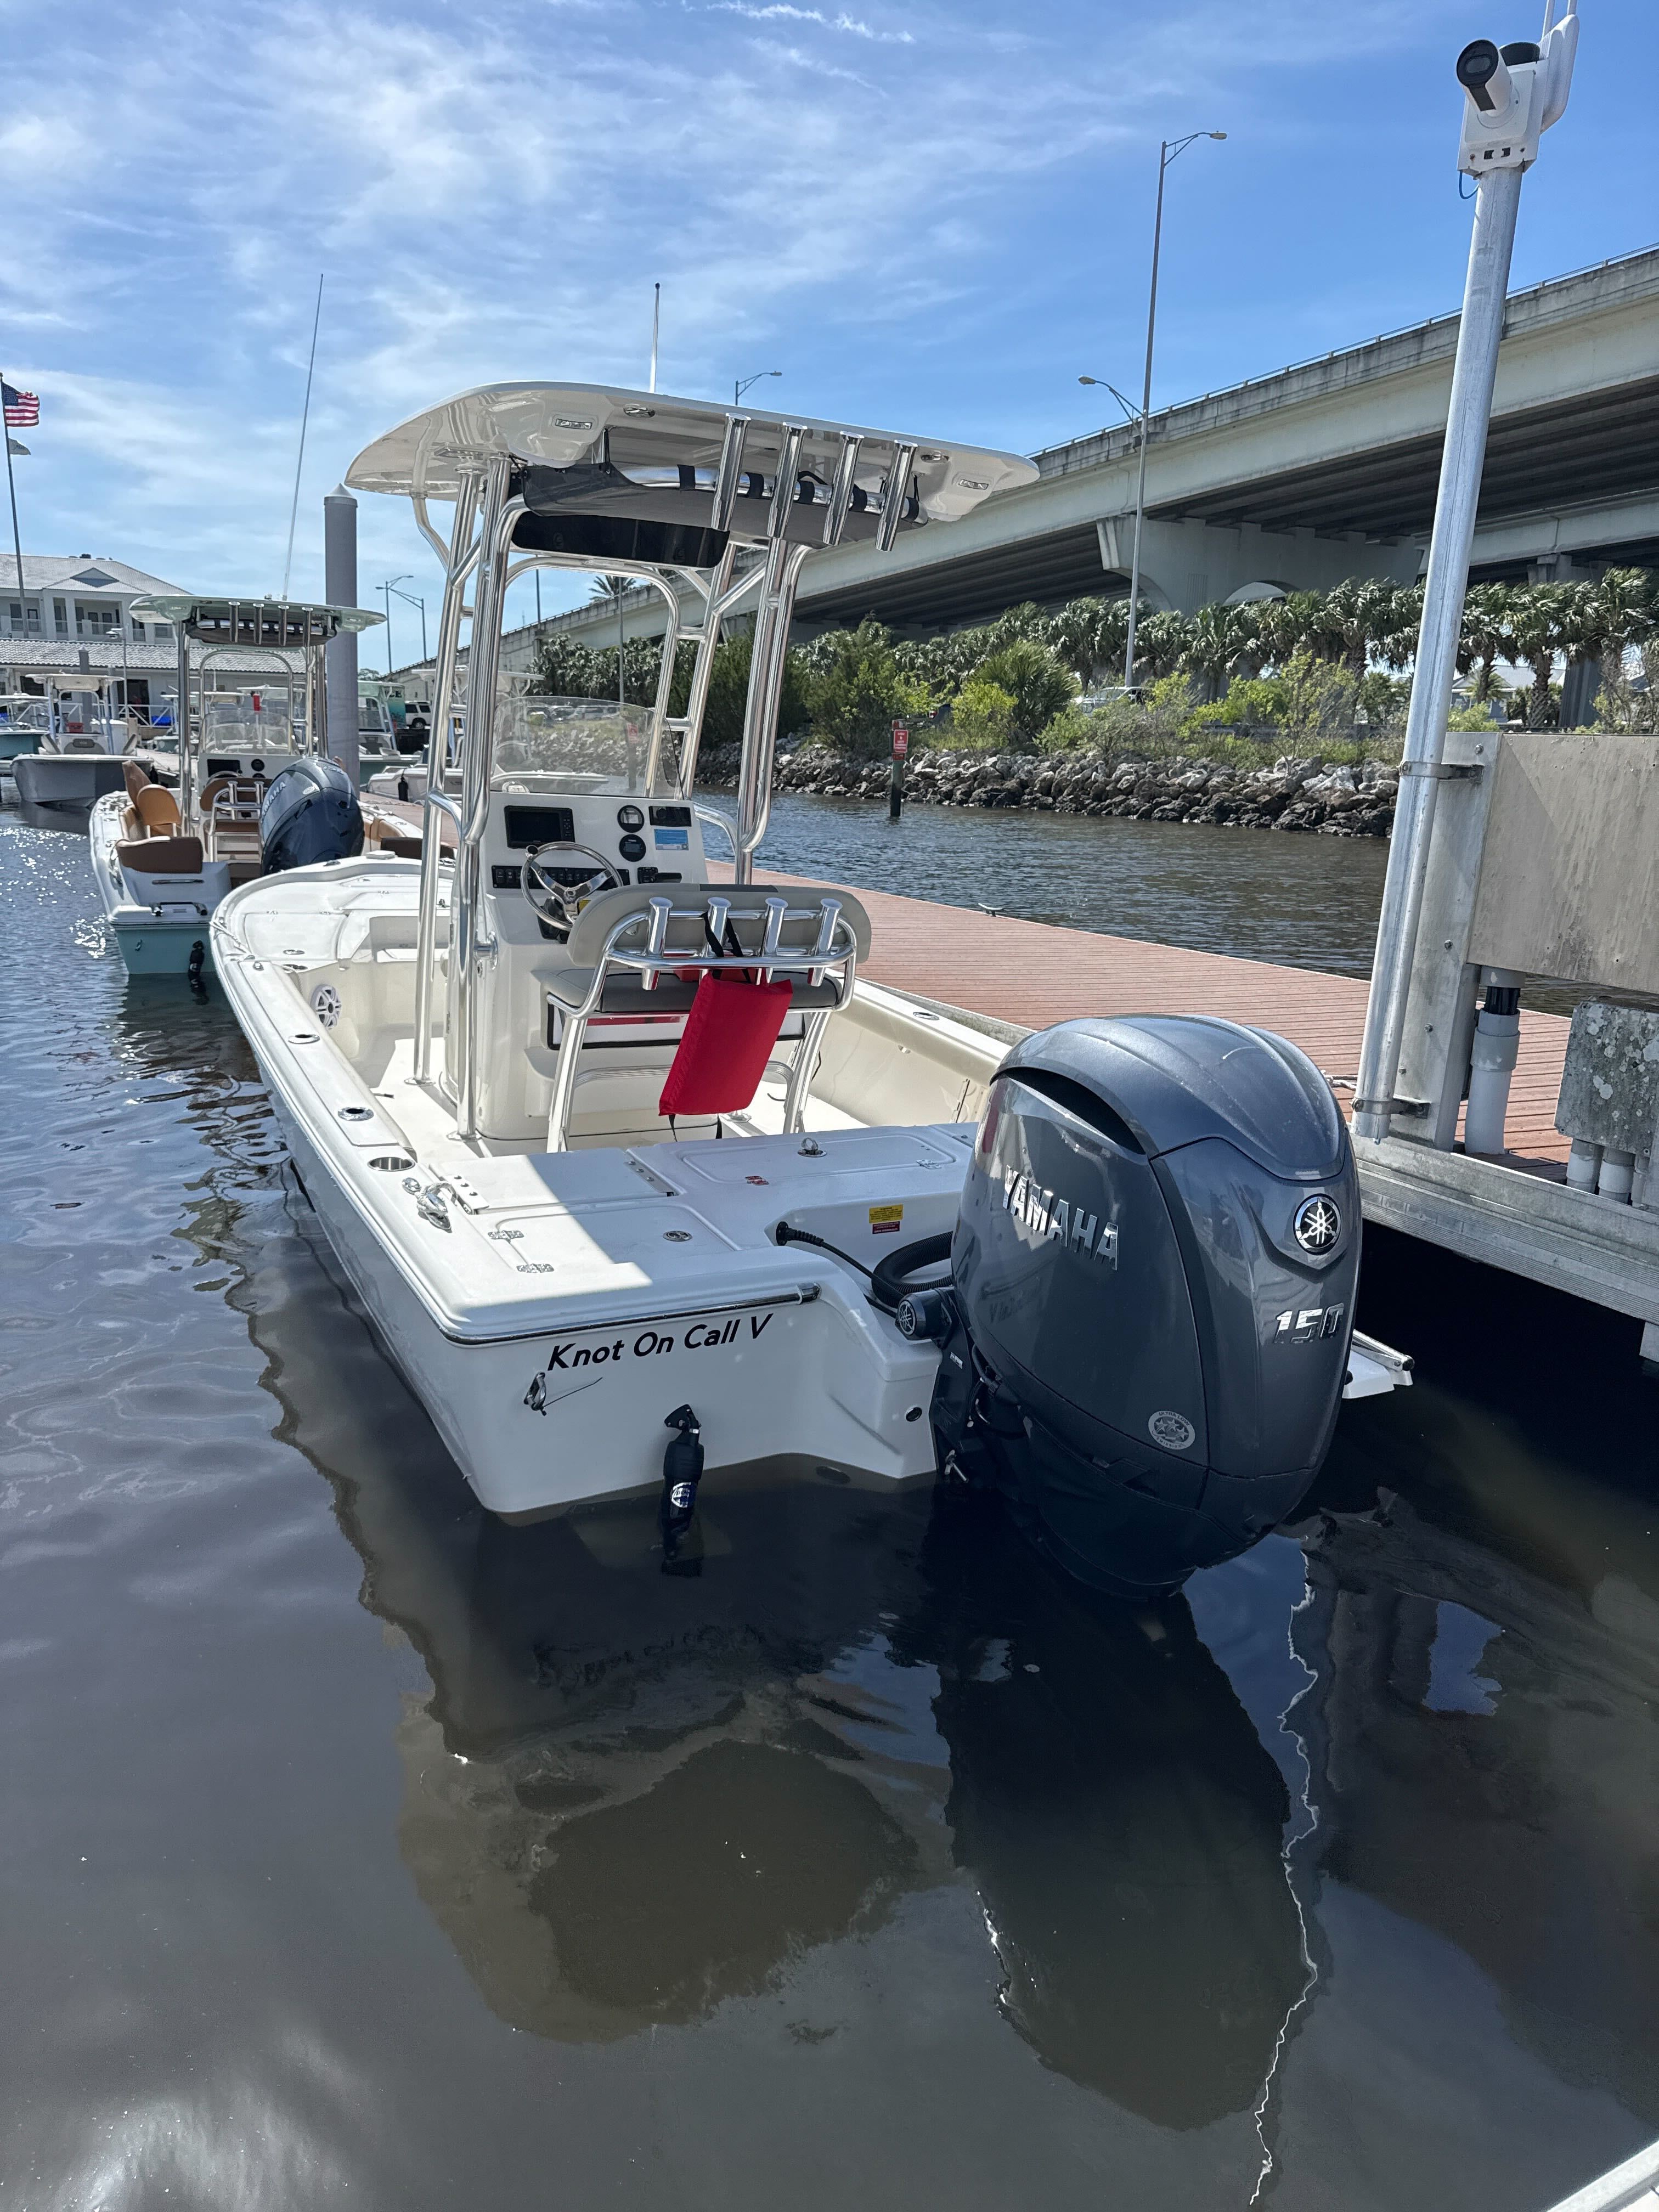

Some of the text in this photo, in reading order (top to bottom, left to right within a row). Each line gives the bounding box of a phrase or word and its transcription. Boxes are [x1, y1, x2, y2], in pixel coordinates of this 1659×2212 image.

[1002, 1164, 1119, 1271] YAMAHA
[547, 1313, 774, 1371] Knot On Call V
[1273, 1302, 1345, 1344] 150
[1177, 1415, 1190, 1426] LOW
